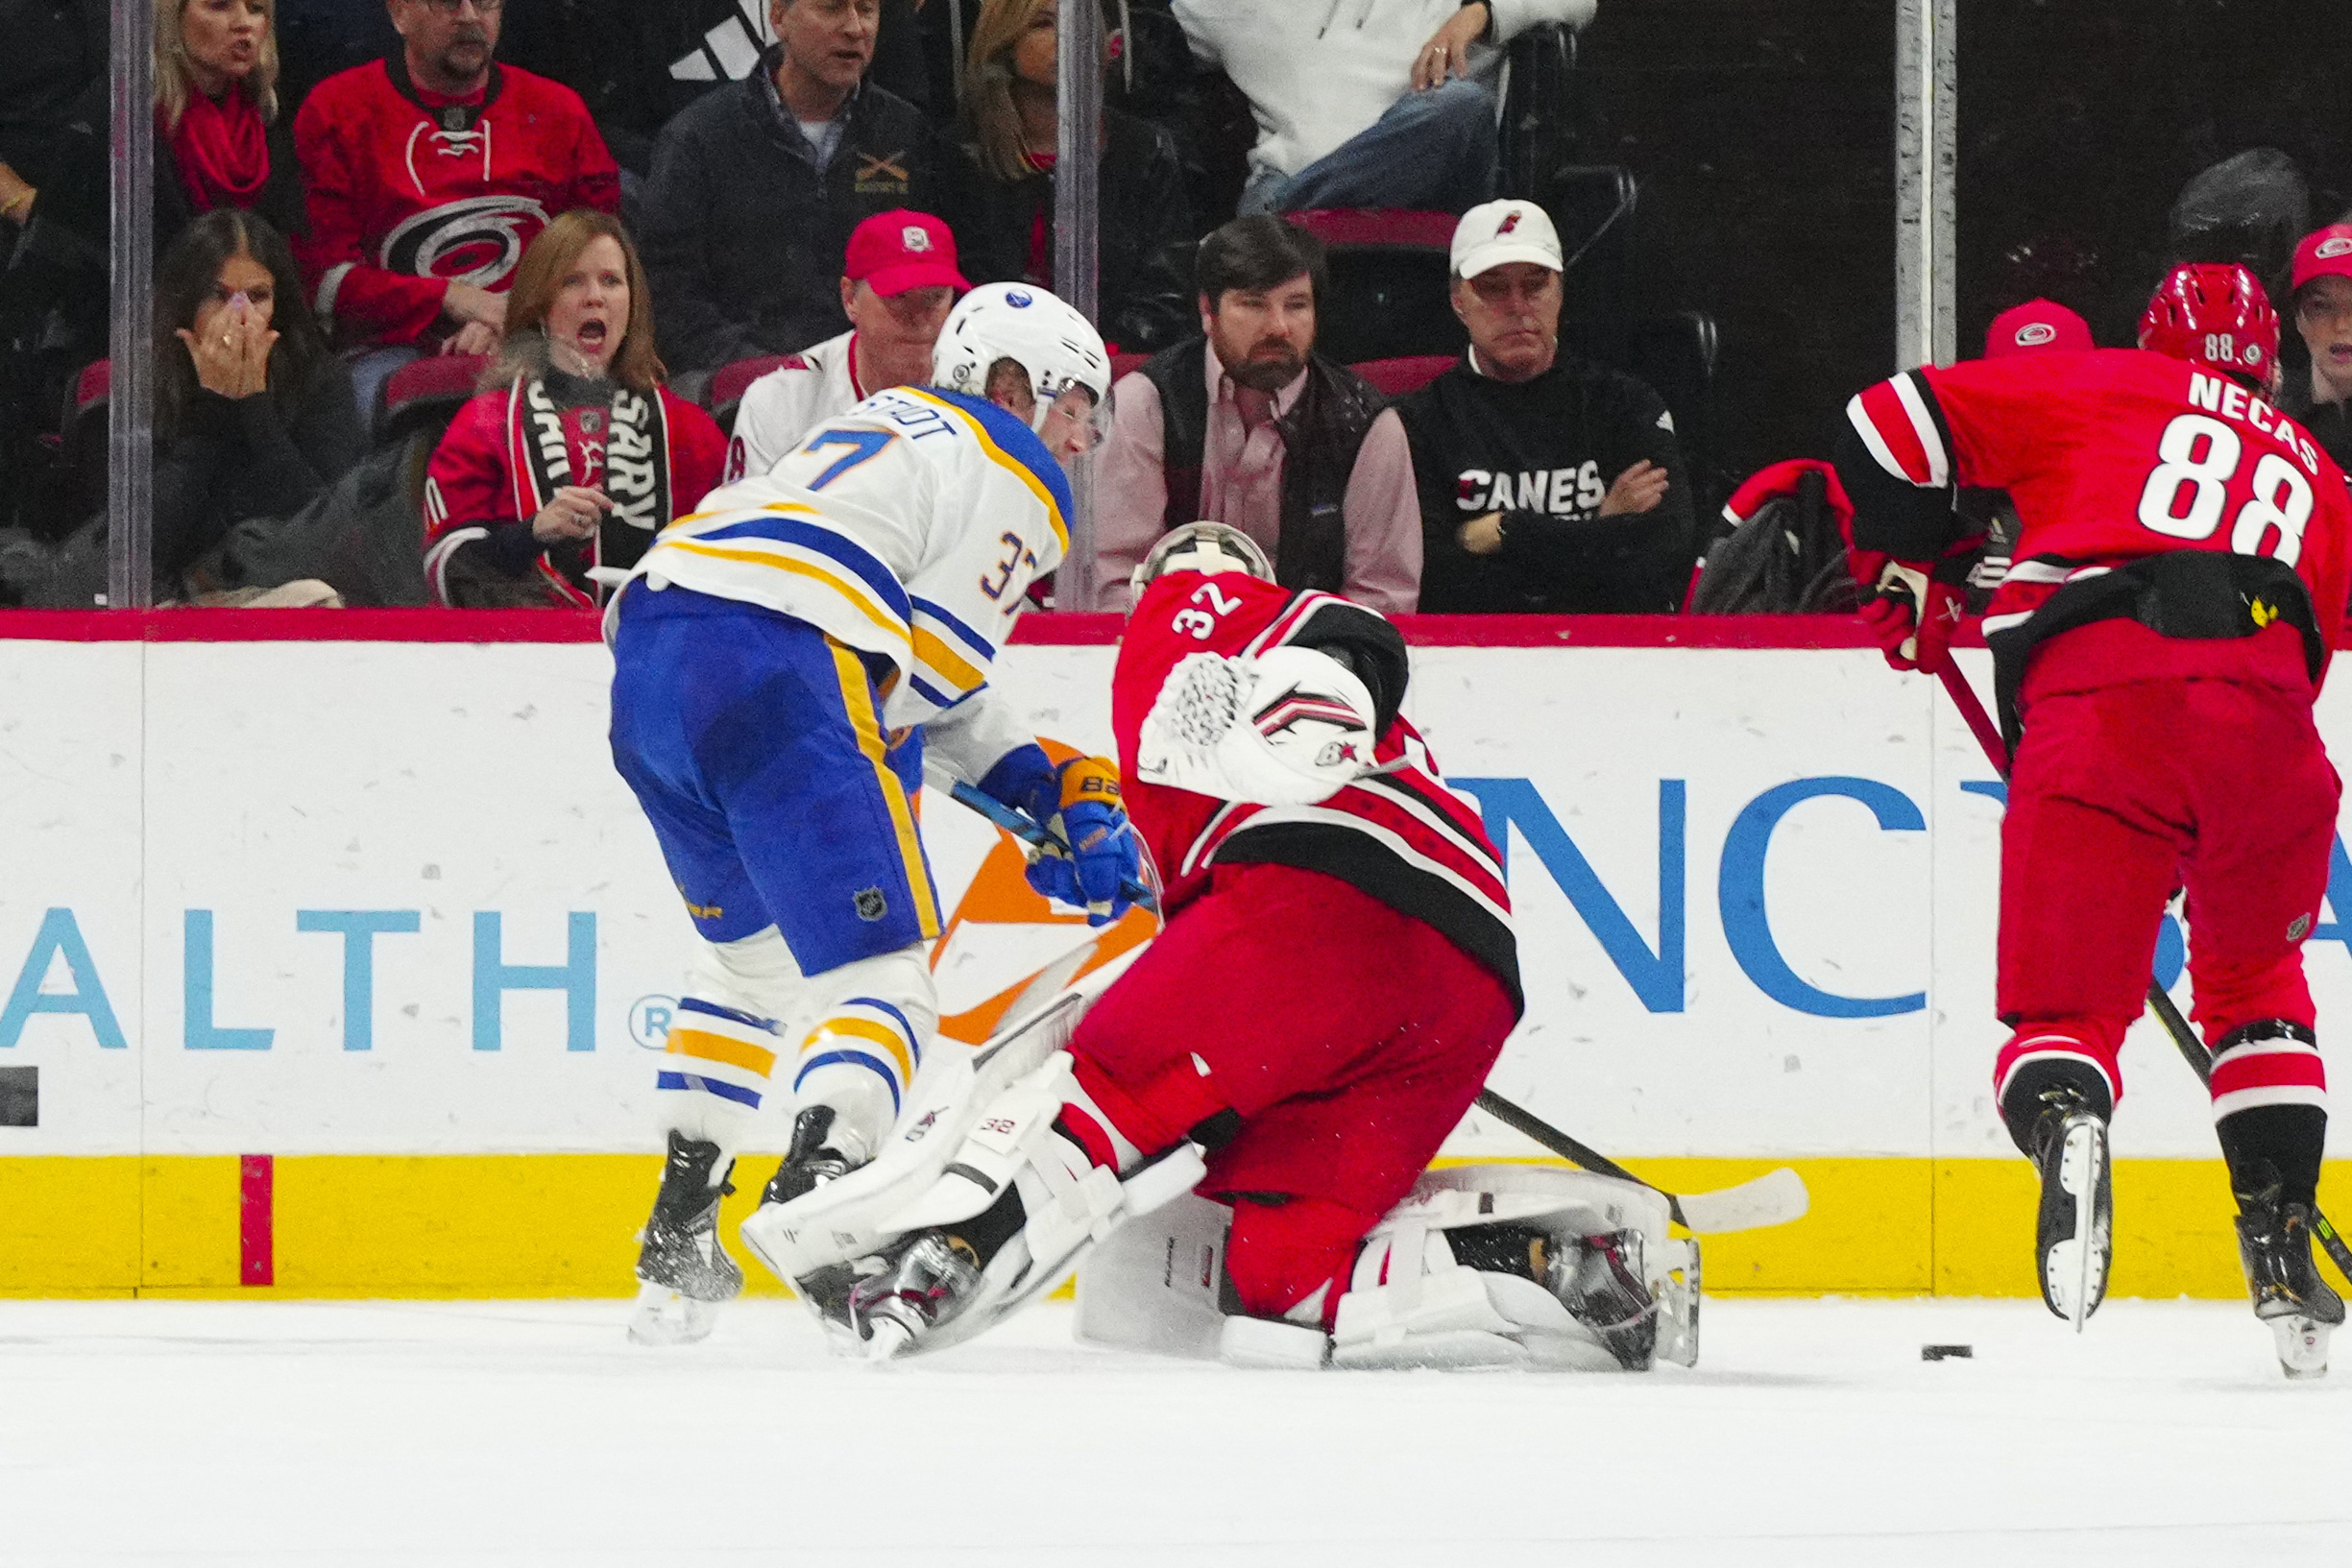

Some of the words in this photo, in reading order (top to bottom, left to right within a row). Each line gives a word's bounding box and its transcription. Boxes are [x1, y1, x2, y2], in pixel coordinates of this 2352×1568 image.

[2205, 333, 2234, 362] 88
[2189, 371, 2319, 476] NECAS
[799, 427, 900, 493] 7
[1455, 459, 1607, 515] CANES
[2138, 414, 2315, 569] 88
[1171, 581, 1244, 640] 32
[0, 907, 597, 1052] ALTH
